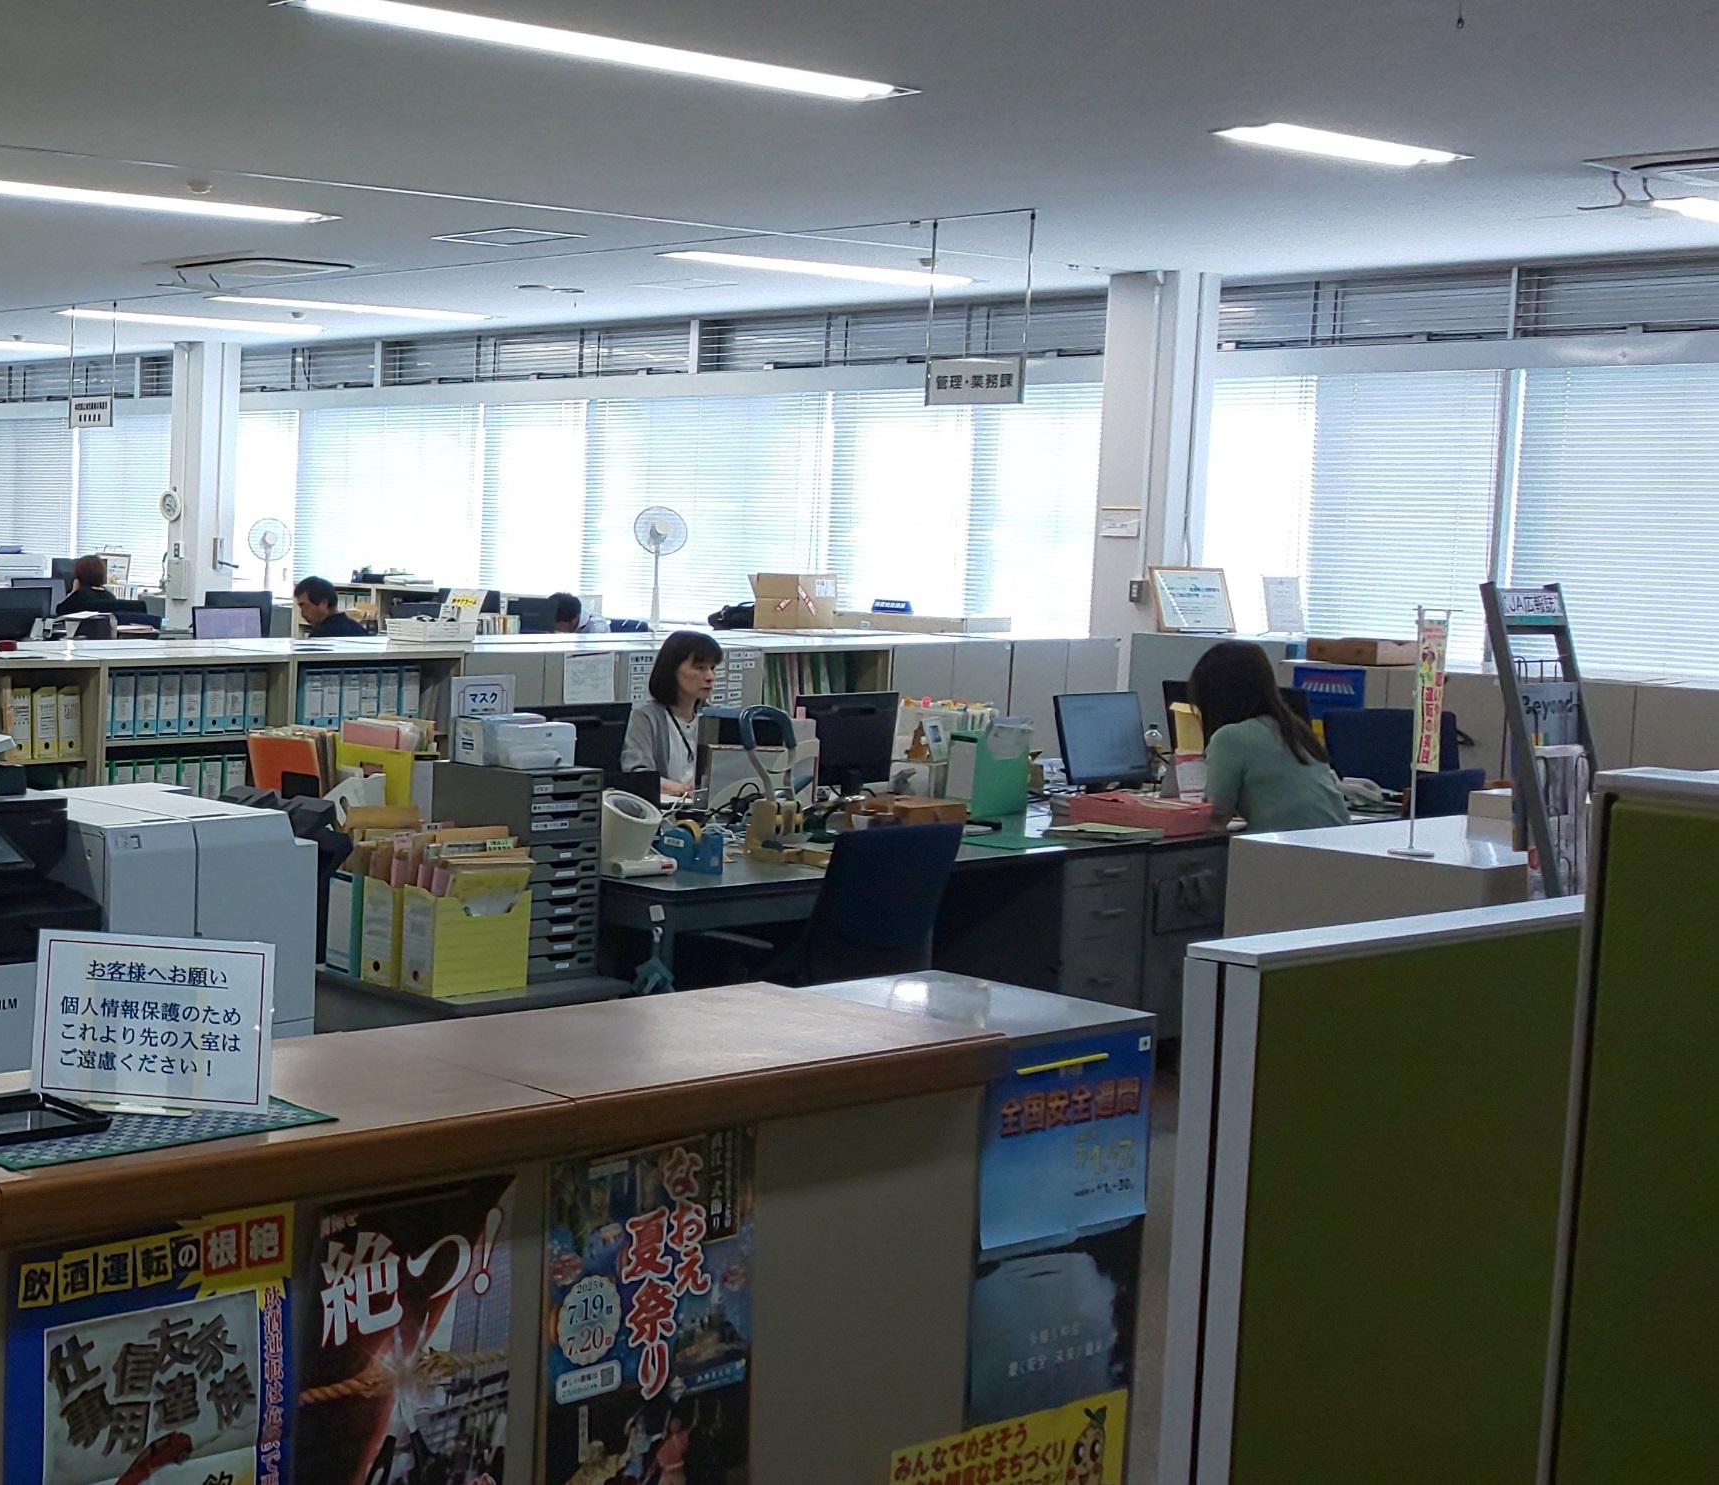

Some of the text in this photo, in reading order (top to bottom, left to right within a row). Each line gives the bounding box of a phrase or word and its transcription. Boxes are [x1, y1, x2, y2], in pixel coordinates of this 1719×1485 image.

[936, 373, 1014, 390] 管理・業務課
[469, 692, 498, 704] マスク
[86, 959, 229, 986] お客様へお願い
[60, 995, 242, 1027] 個人情報保護のため
[60, 1022, 242, 1053] これより先の入室は
[59, 1048, 213, 1078] ご遠慮ください!
[663, 1146, 712, 1296] なおえ
[23, 1222, 281, 1302] 飲酒運転の根絶
[320, 1207, 503, 1348] 絶つ!
[567, 1294, 605, 1326] 7.19
[622, 1204, 677, 1400] 夏祭り
[566, 1324, 605, 1357] 7.20
[894, 1422, 1028, 1482] みんなでめざそう
